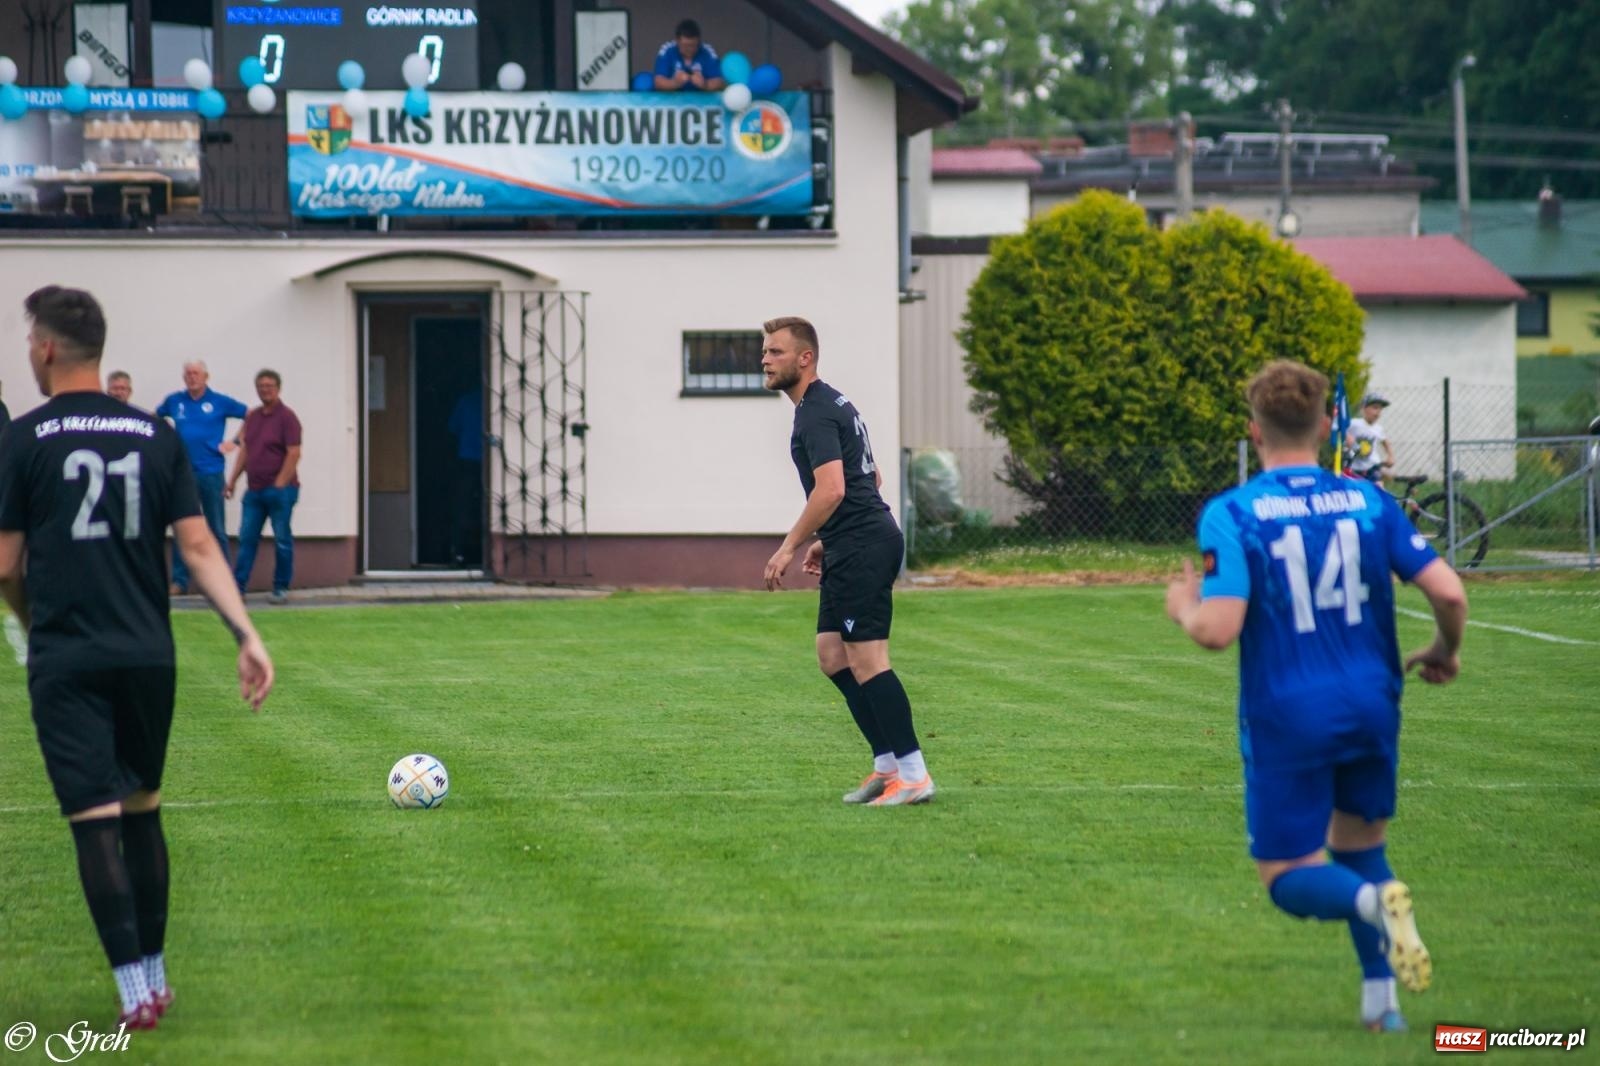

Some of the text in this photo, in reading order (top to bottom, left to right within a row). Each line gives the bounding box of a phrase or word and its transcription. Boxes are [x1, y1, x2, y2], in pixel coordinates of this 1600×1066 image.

[366, 5, 424, 25] GÓRNIK
[260, 34, 285, 83] 0
[369, 102, 723, 145] LKS KRZYŻANOWICE
[571, 154, 726, 183] 1920-2020
[63, 449, 141, 541] 21
[1270, 518, 1370, 634] 14
